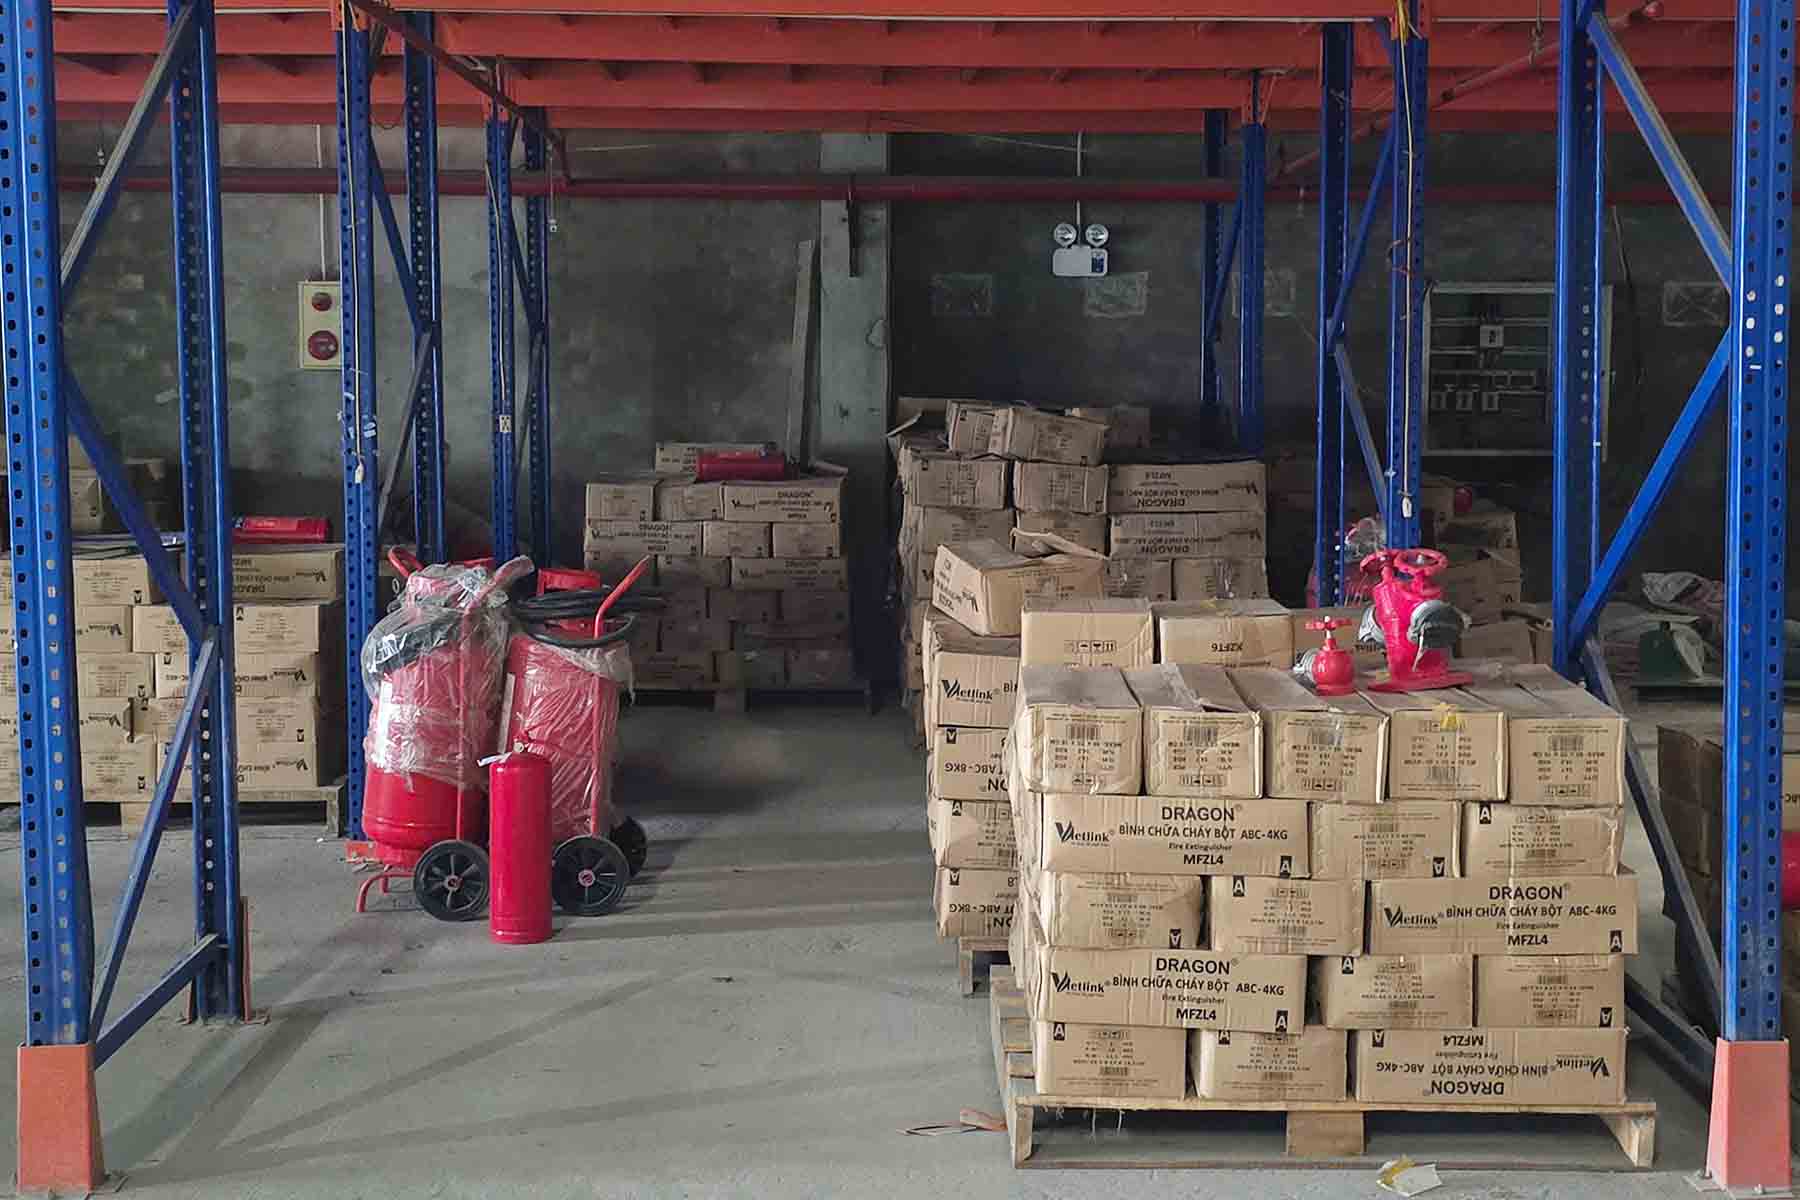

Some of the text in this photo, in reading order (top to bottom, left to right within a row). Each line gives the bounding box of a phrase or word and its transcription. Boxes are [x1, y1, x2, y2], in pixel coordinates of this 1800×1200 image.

[1136, 498, 1186, 508] DRAGON
[1161, 806, 1235, 822] DRAGON
[1055, 821, 1110, 842] Vietlink
[1119, 825, 1146, 837] BÌNH
[1214, 825, 1235, 840] BỘT
[1240, 829, 1288, 840] ABC-4KG
[1183, 854, 1224, 865] MFZL4
[1489, 886, 1563, 900] DRAGON
[1384, 906, 1438, 927] Vietlink
[1446, 904, 1616, 919] BÌNH CHỮA CHÁY BỘT ABC-4KG
[1507, 935, 1548, 946] MFZL4
[1155, 958, 1231, 975] DRAGON
[1052, 971, 1105, 993] Vietlink
[1112, 974, 1284, 995] BÌNH CHỮA CHÁY BỘT ABC-4KG
[1176, 1008, 1217, 1021] MFZL4
[1443, 1035, 1484, 1046] MFZL4
[1376, 1061, 1548, 1077] BÌNH CHỮA CHÁY BỘT ABC-4KG
[1556, 1057, 1609, 1078] Vietlink
[1431, 1080, 1504, 1095] DRAGON
